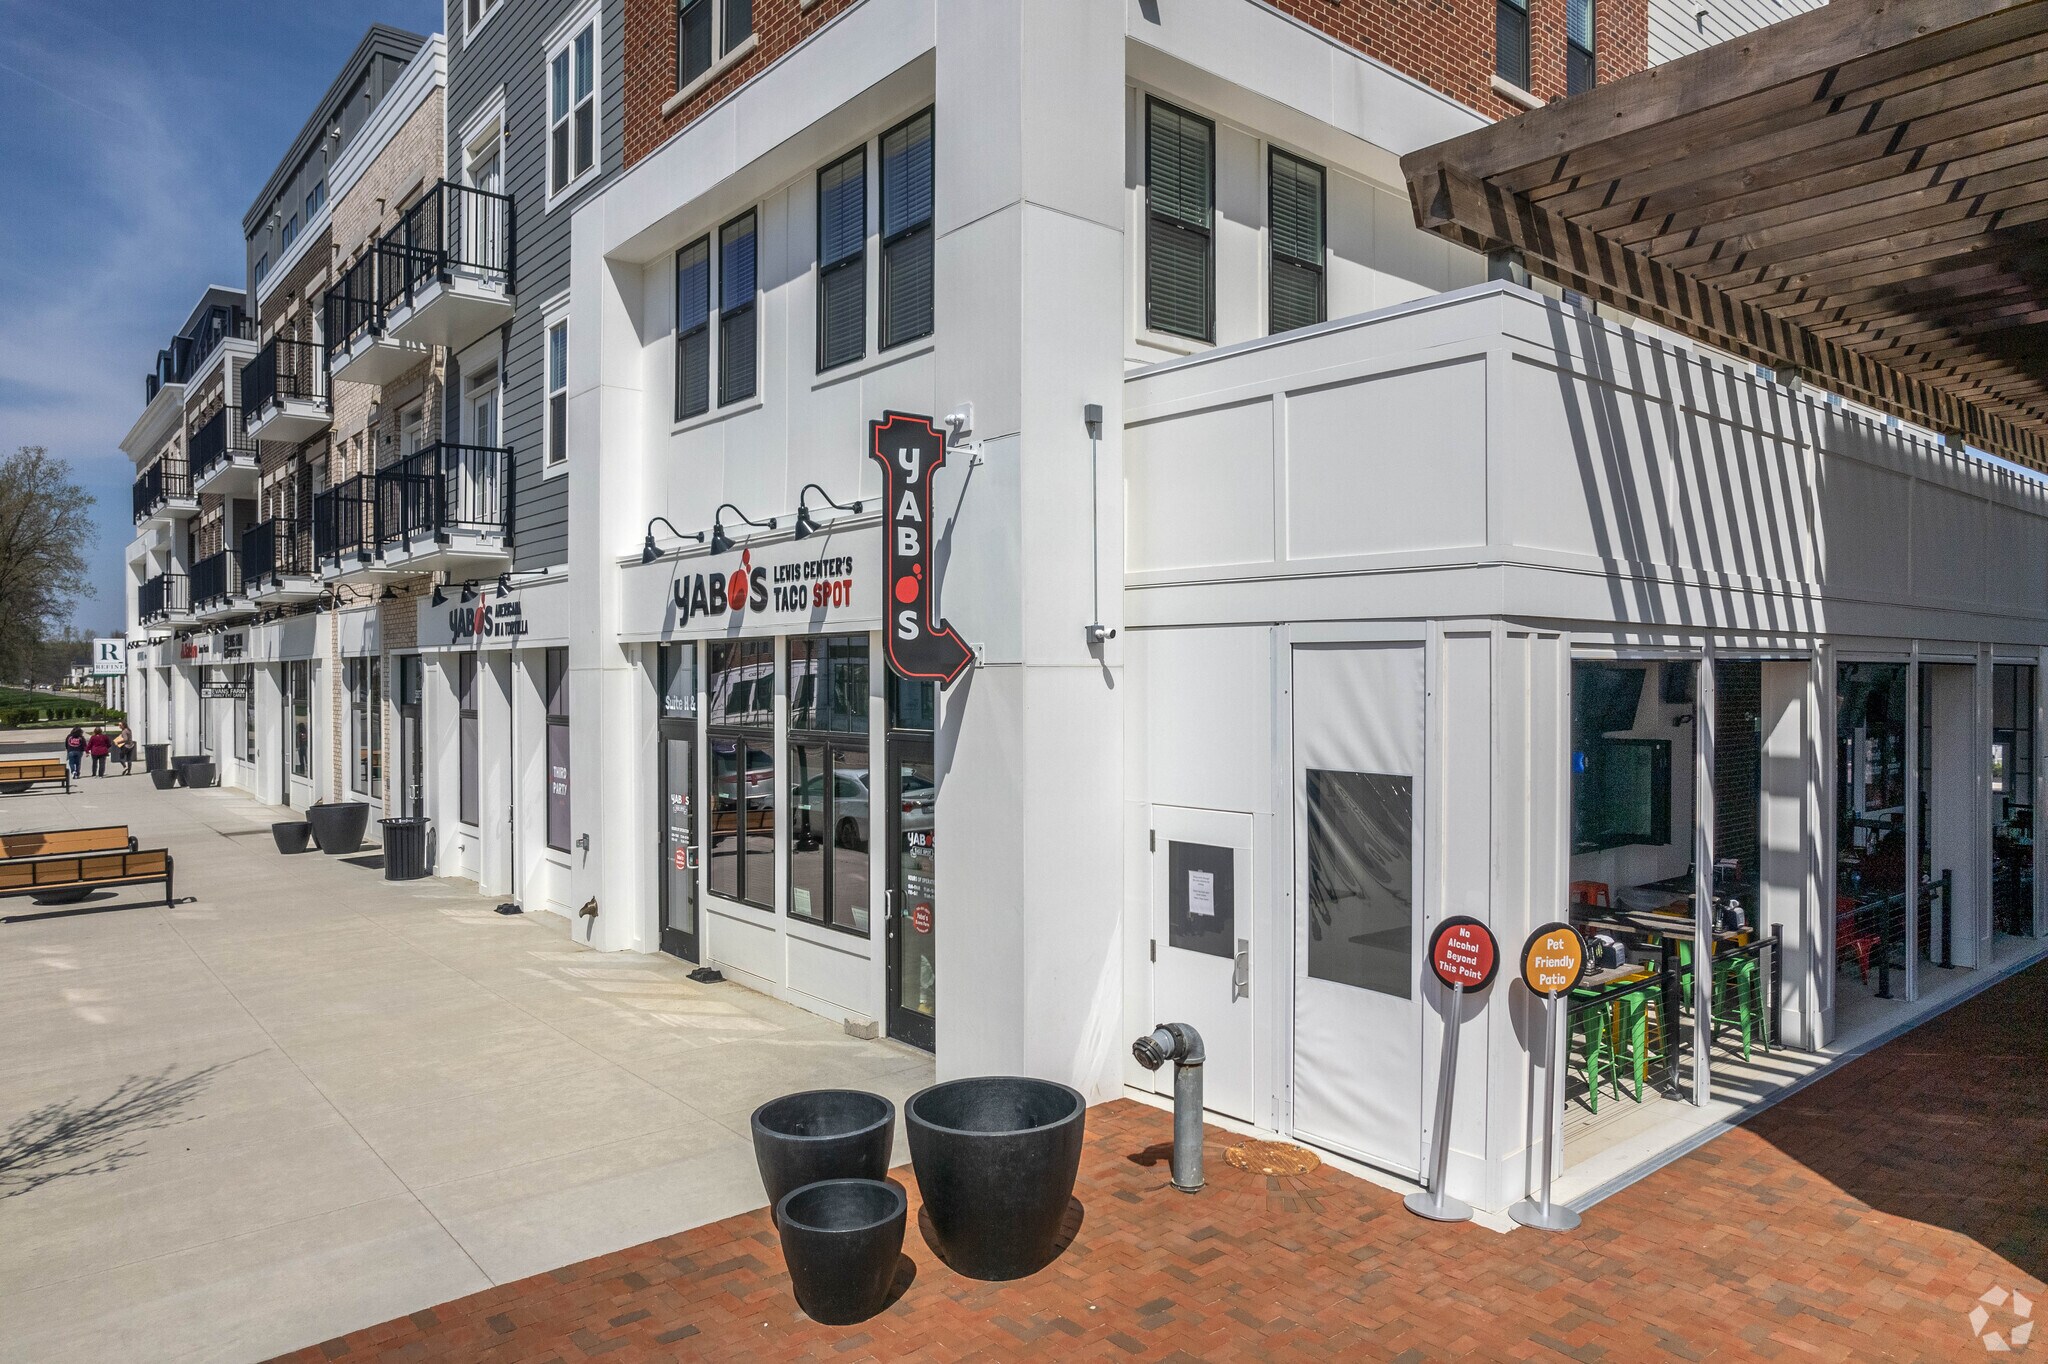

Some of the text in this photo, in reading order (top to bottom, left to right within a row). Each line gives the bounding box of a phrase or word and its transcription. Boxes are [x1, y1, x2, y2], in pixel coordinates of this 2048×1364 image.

[803, 556, 853, 581] CENTER'S
[773, 579, 853, 612] TACO SPOT
[101, 643, 119, 660] R
[665, 694, 683, 710] Suite
[1459, 927, 1471, 938] No
[1448, 938, 1479, 953] Alcohol
[1547, 938, 1564, 950] Pet
[1446, 950, 1477, 966] Beyond
[1535, 956, 1575, 969] Friendly
[1439, 961, 1482, 980] This Point
[1539, 973, 1566, 985] Patio
